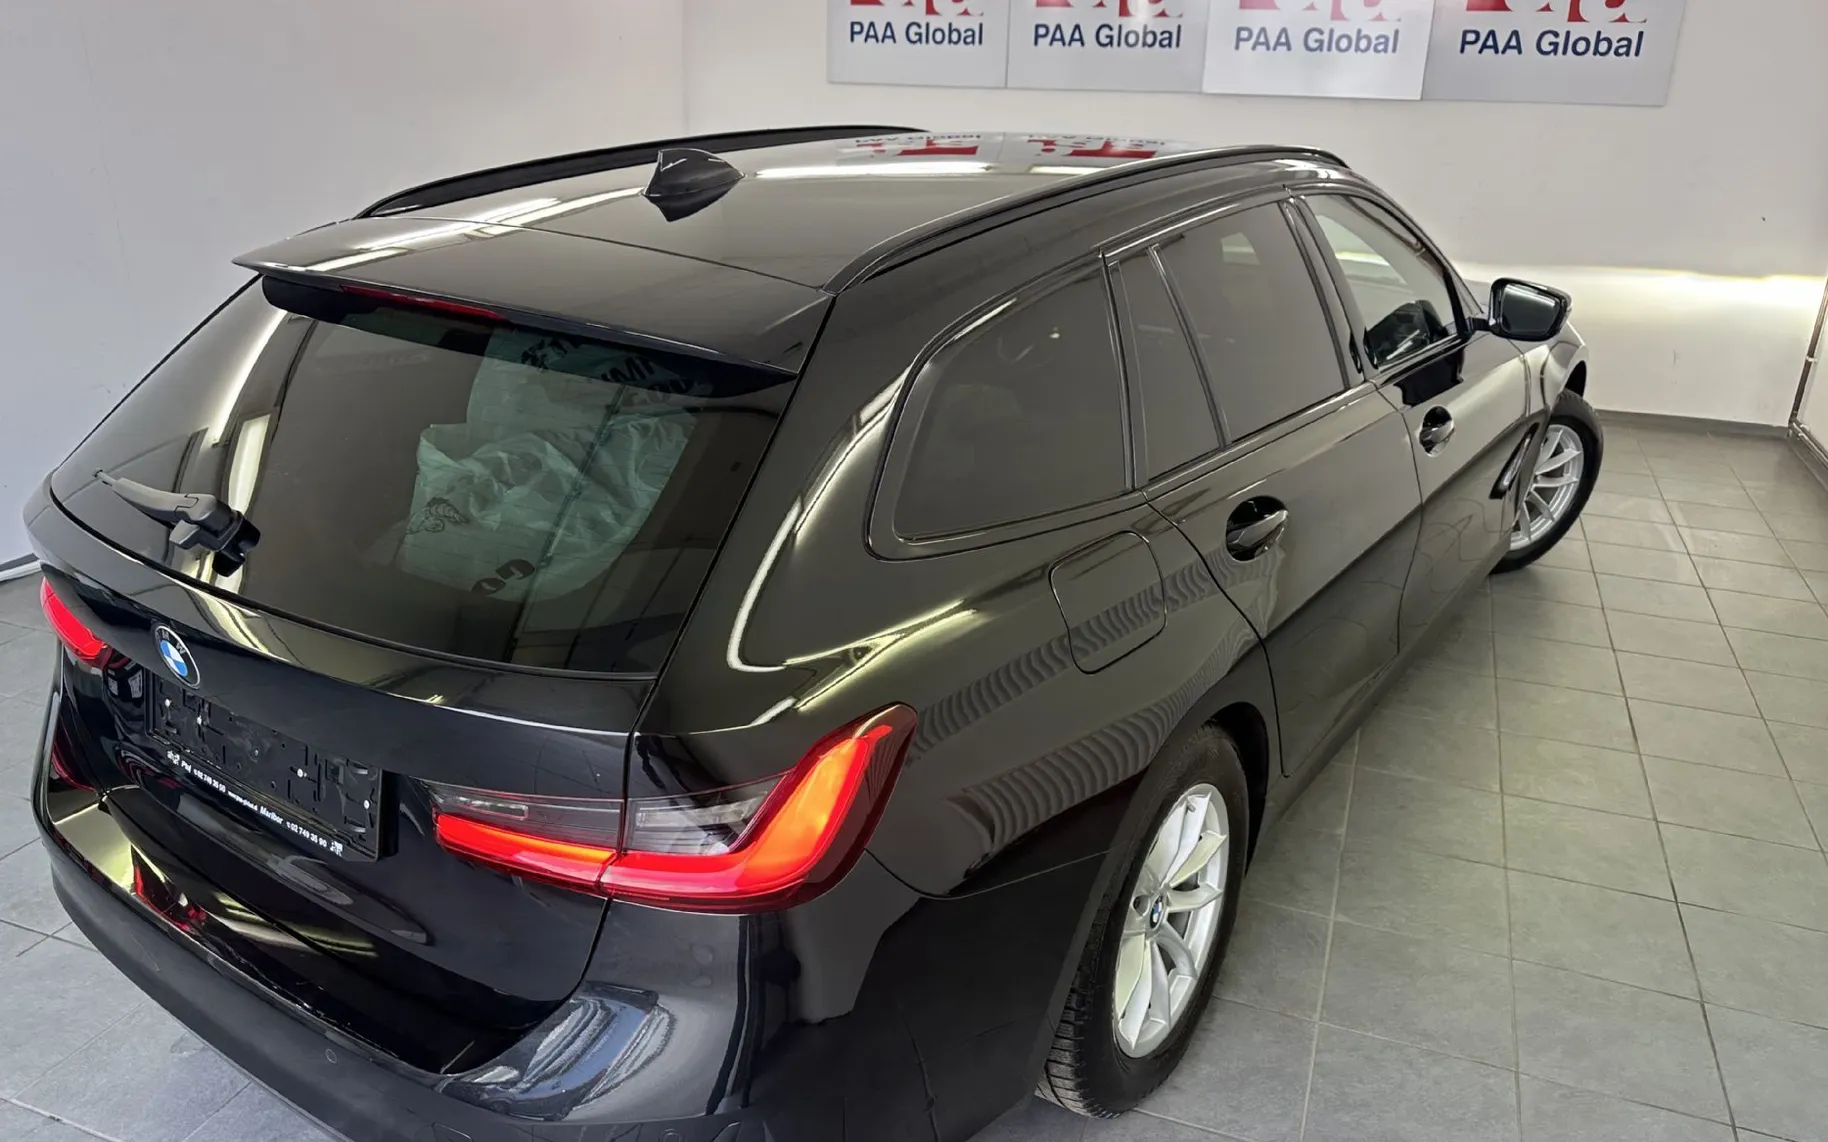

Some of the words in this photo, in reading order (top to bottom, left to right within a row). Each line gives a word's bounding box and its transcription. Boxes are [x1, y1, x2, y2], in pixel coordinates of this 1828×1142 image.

[849, 21, 897, 45] PAA
[905, 21, 984, 46] Global
[1033, 24, 1085, 48] PAA
[1094, 24, 1182, 49] Global
[1234, 26, 1293, 53] PAA
[1302, 27, 1400, 54] Global
[1459, 29, 1524, 56] PAA
[1535, 30, 1645, 58] Global
[260, 805, 283, 825] Maribor
